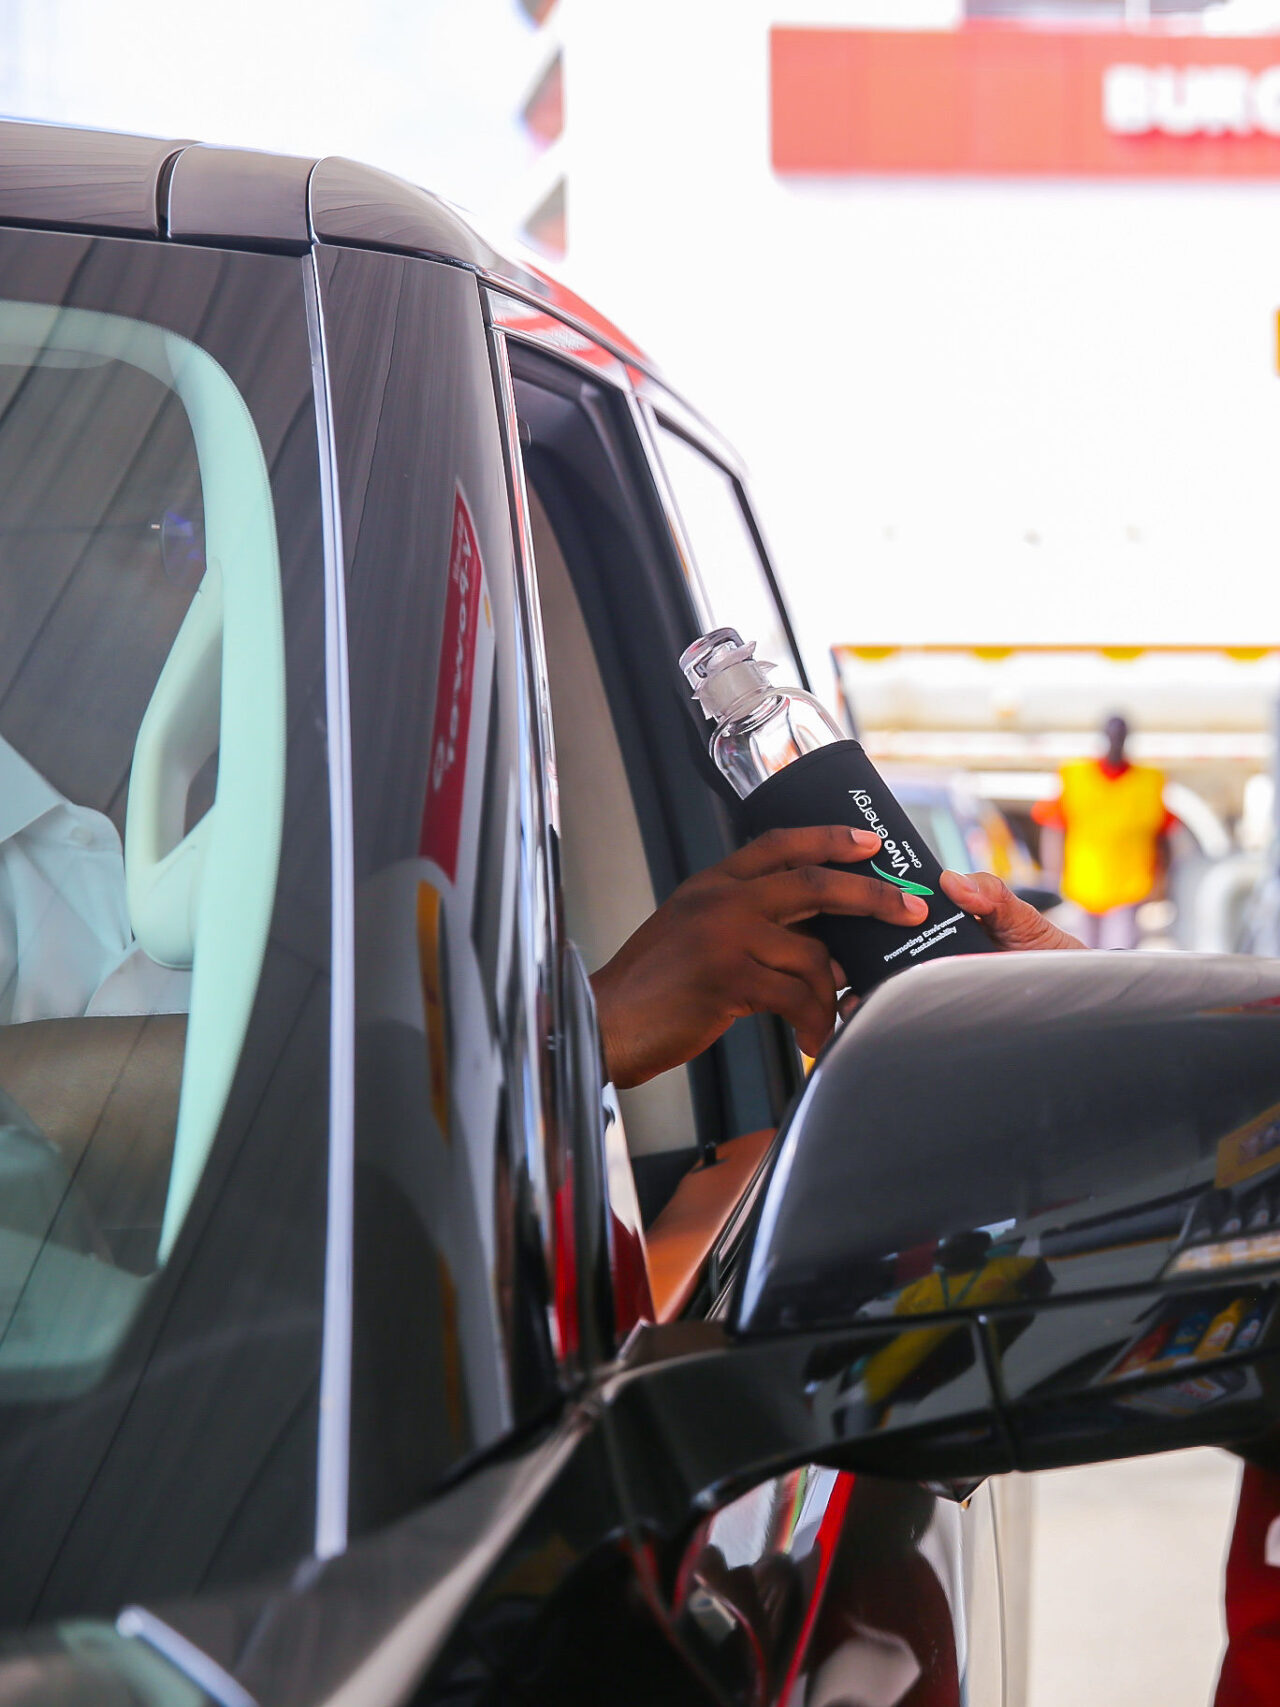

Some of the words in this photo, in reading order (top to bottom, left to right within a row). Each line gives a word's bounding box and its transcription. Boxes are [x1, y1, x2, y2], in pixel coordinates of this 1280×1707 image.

[848, 790, 888, 839] energy
[902, 841, 922, 869] Ghana
[883, 935, 924, 962] Promoting
[909, 926, 957, 957] Sustainability
